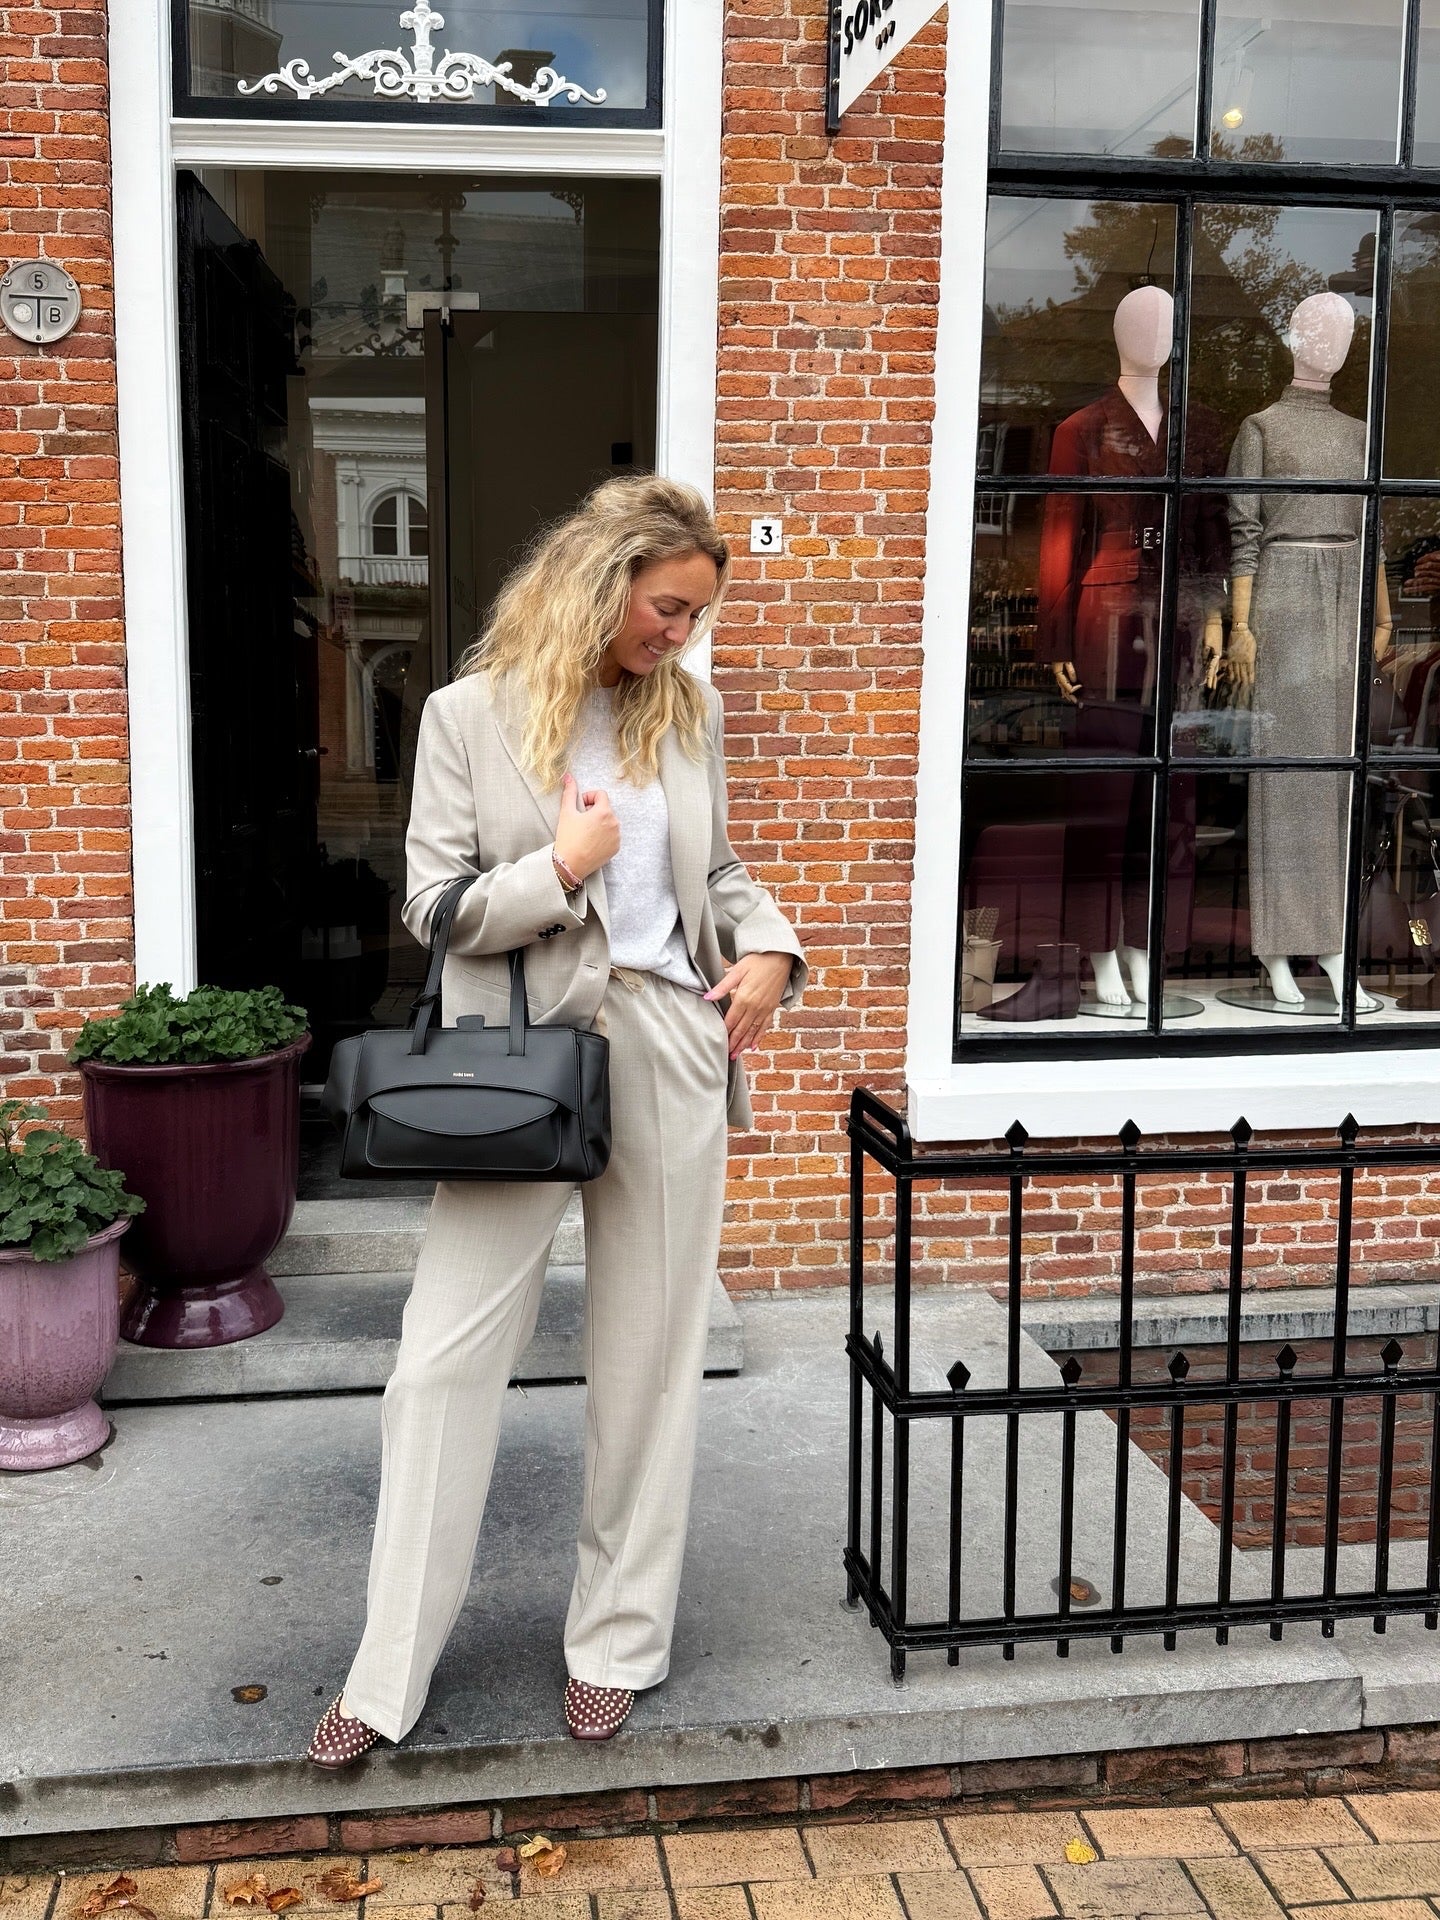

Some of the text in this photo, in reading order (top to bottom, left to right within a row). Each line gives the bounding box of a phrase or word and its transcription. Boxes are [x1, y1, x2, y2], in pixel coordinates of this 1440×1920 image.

[844, 0, 893, 54] SOR
[34, 274, 43, 289] 5
[49, 307, 61, 323] B
[760, 525, 773, 546] 3
